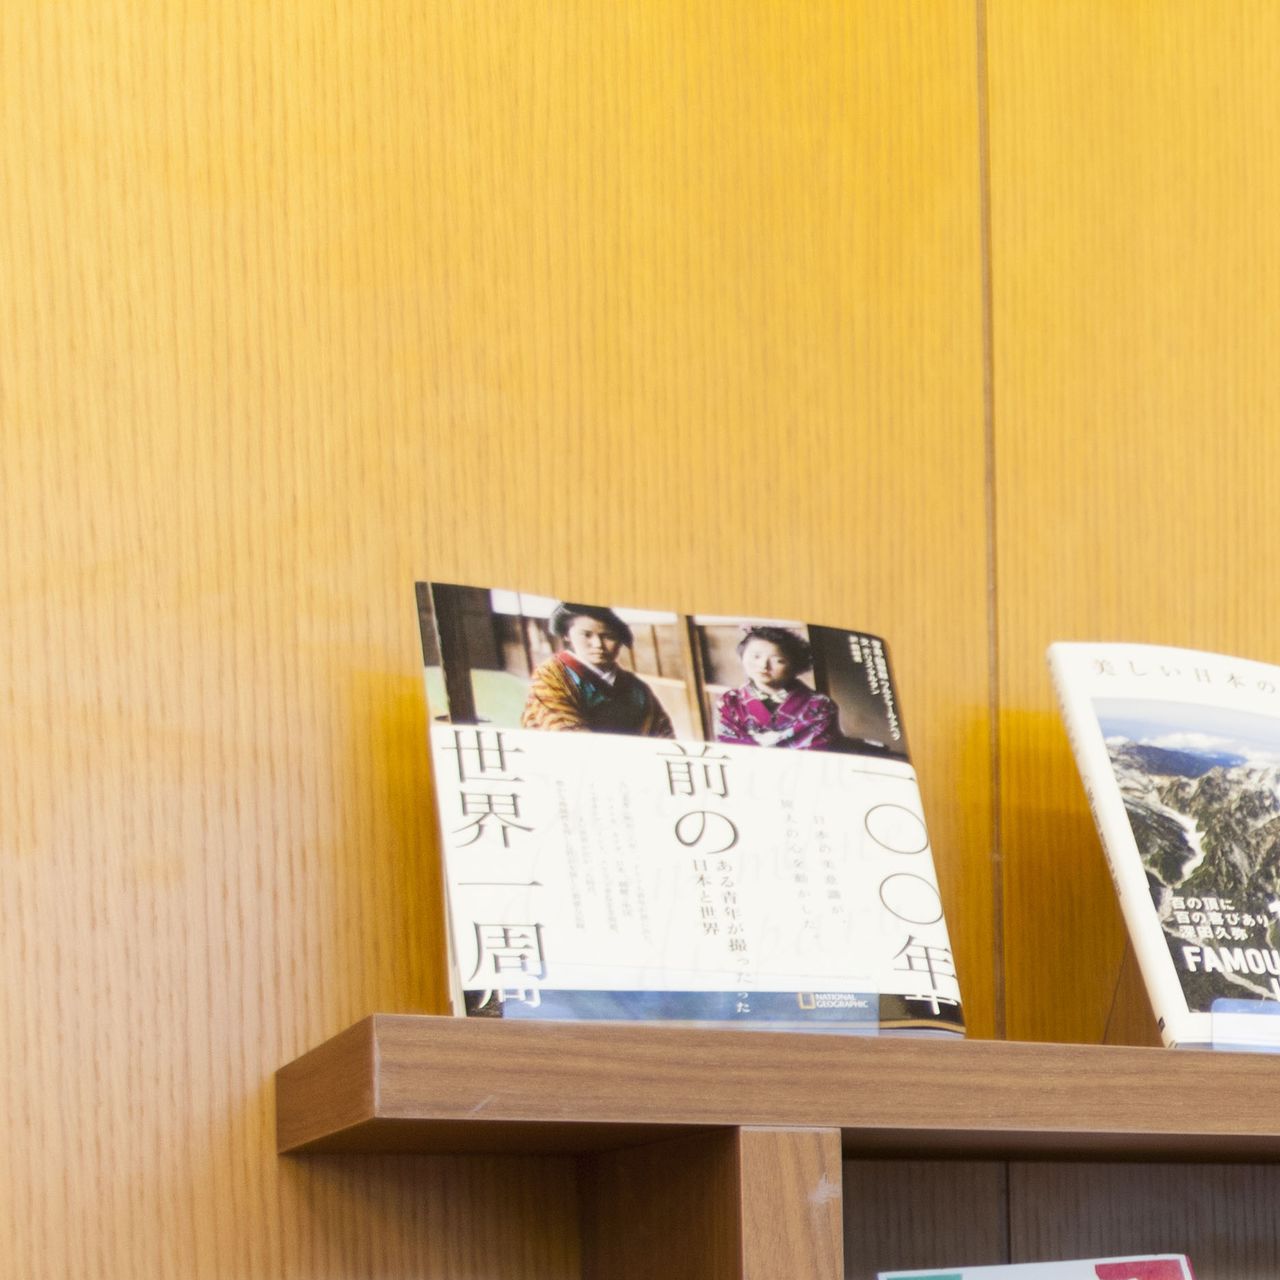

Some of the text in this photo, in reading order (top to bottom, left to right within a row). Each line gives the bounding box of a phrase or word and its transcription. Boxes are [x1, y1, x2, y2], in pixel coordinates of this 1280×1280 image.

[656, 741, 739, 854] 前の
[440, 728, 548, 981] 世界一周
[691, 858, 721, 936] 日本と世界
[815, 993, 857, 1002] NATIONAL
[815, 1000, 870, 1009] GEOGRAPHIC
